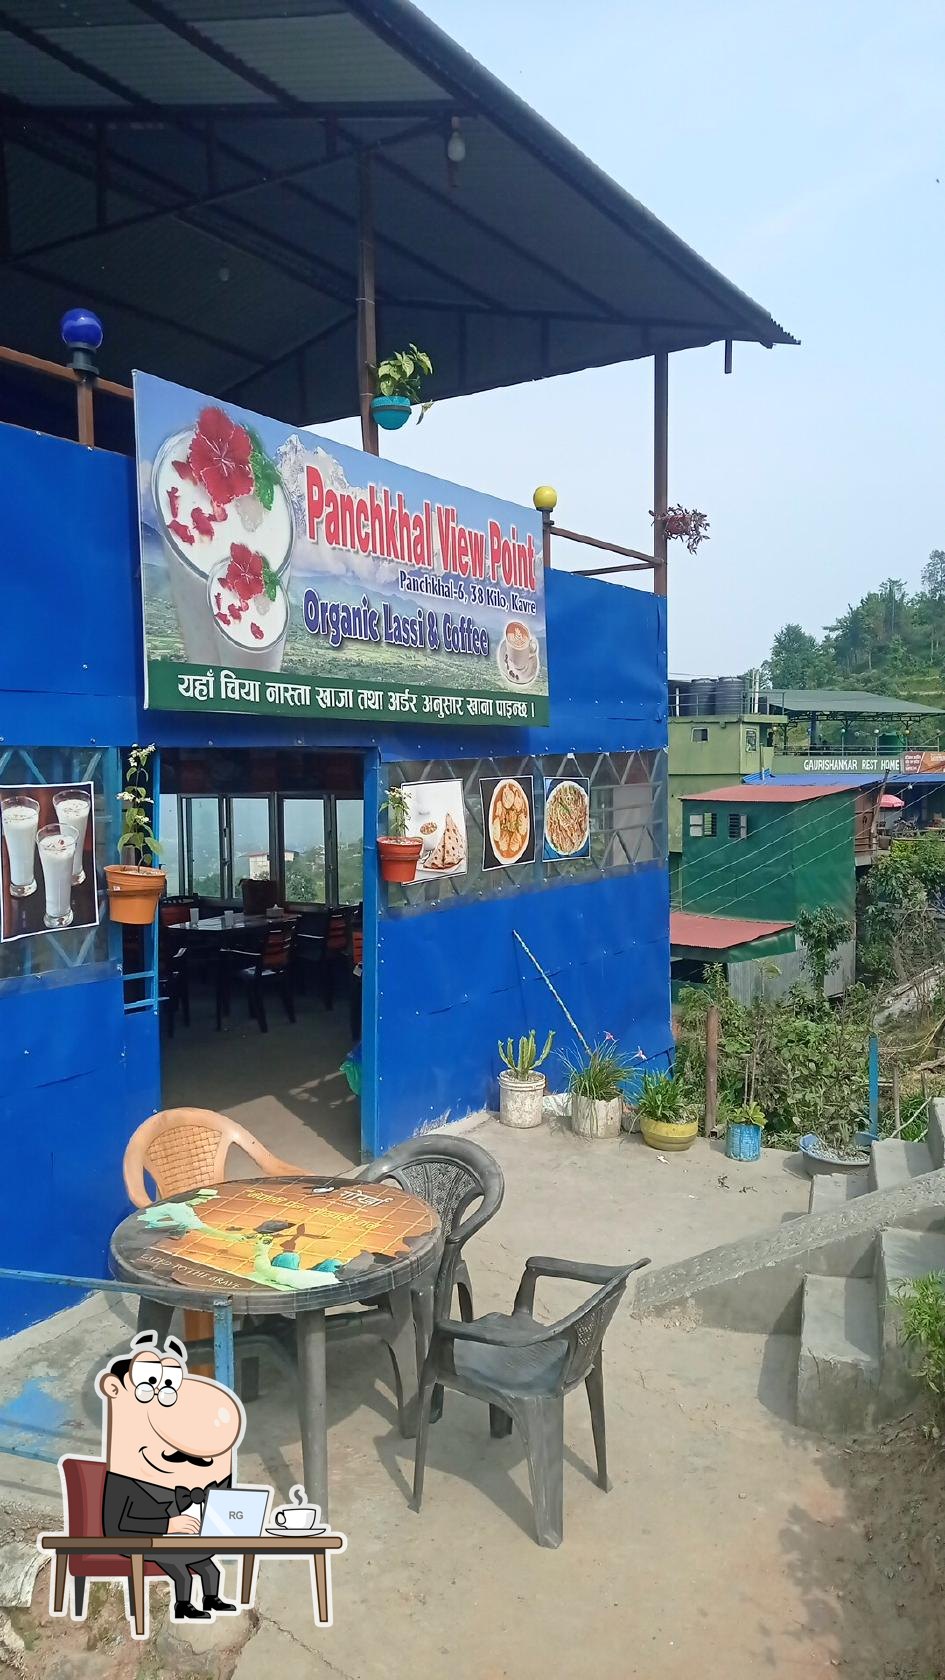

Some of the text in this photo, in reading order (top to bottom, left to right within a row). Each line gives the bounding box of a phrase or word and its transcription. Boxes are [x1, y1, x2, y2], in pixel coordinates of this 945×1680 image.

[305, 464, 537, 592] Panchkhal View Point
[400, 571, 537, 614] Panchkhal-6, 38 Kilo, Kavre
[303, 588, 490, 656] Organic Lassi & Coffee
[177, 668, 215, 701] यहाँ
[220, 669, 261, 703] चिया
[265, 682, 312, 707] नास्ता
[315, 686, 354, 709] खाजा
[357, 688, 384, 711] तथा
[388, 688, 418, 714] अर्डर
[422, 694, 464, 719] अनुसार
[466, 697, 493, 717] खाना
[495, 699, 528, 720] पाइन्छ
[803, 759, 858, 771] GAURISHANKAR
[861, 759, 878, 771] REST
[880, 759, 900, 771] HOME
[208, 1274, 242, 1290] BRAVE
